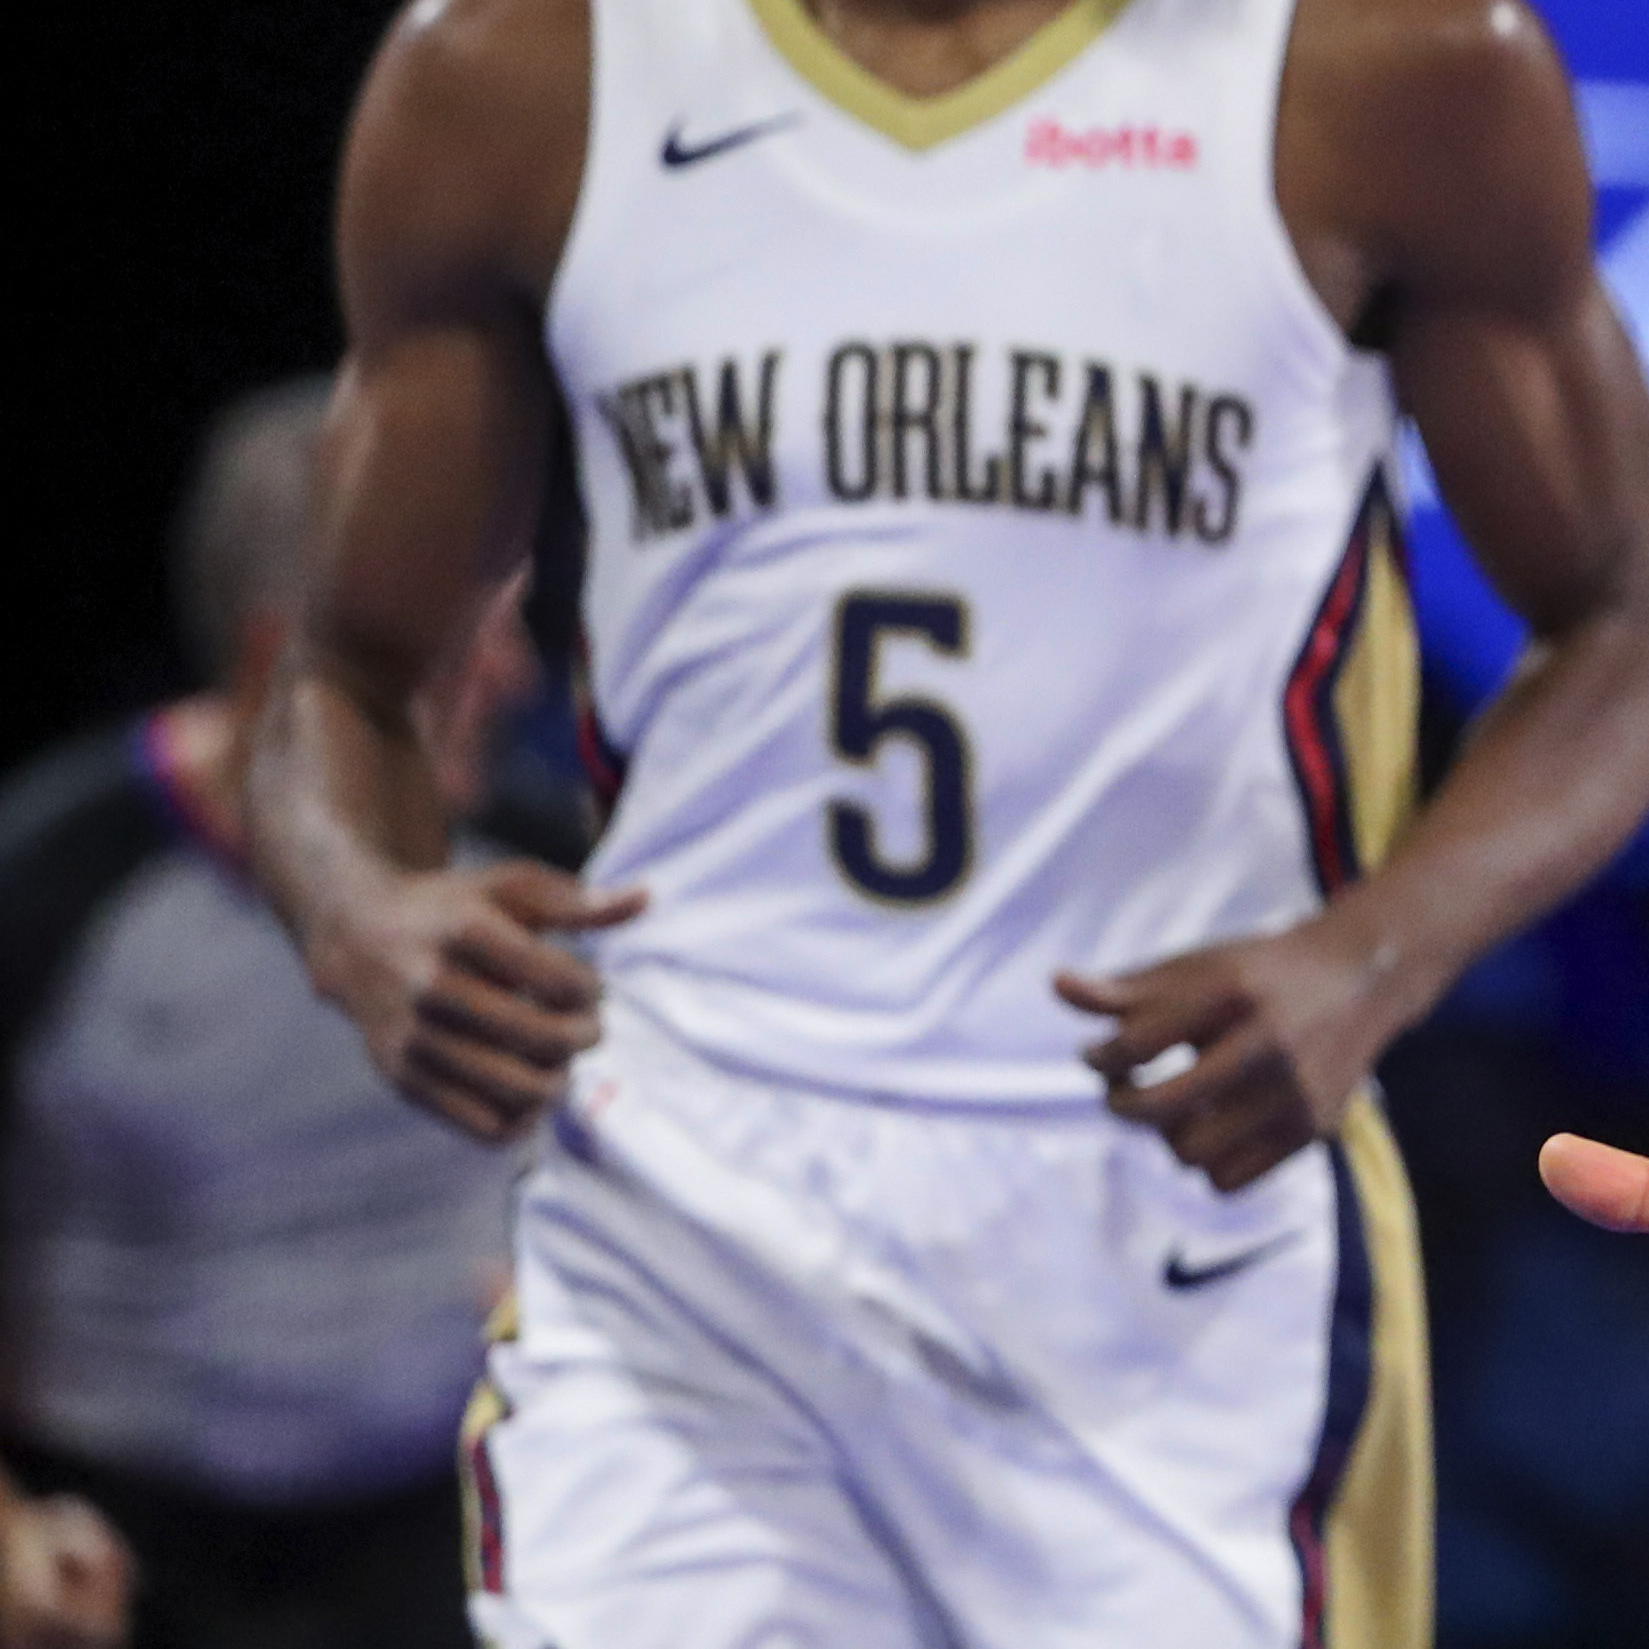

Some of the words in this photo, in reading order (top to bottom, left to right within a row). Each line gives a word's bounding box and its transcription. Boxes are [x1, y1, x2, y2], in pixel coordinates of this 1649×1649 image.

[1025, 115, 1200, 172] ibotta
[600, 347, 785, 544] NEW
[823, 340, 1254, 545] ORLEANS
[825, 588, 975, 914] 5
